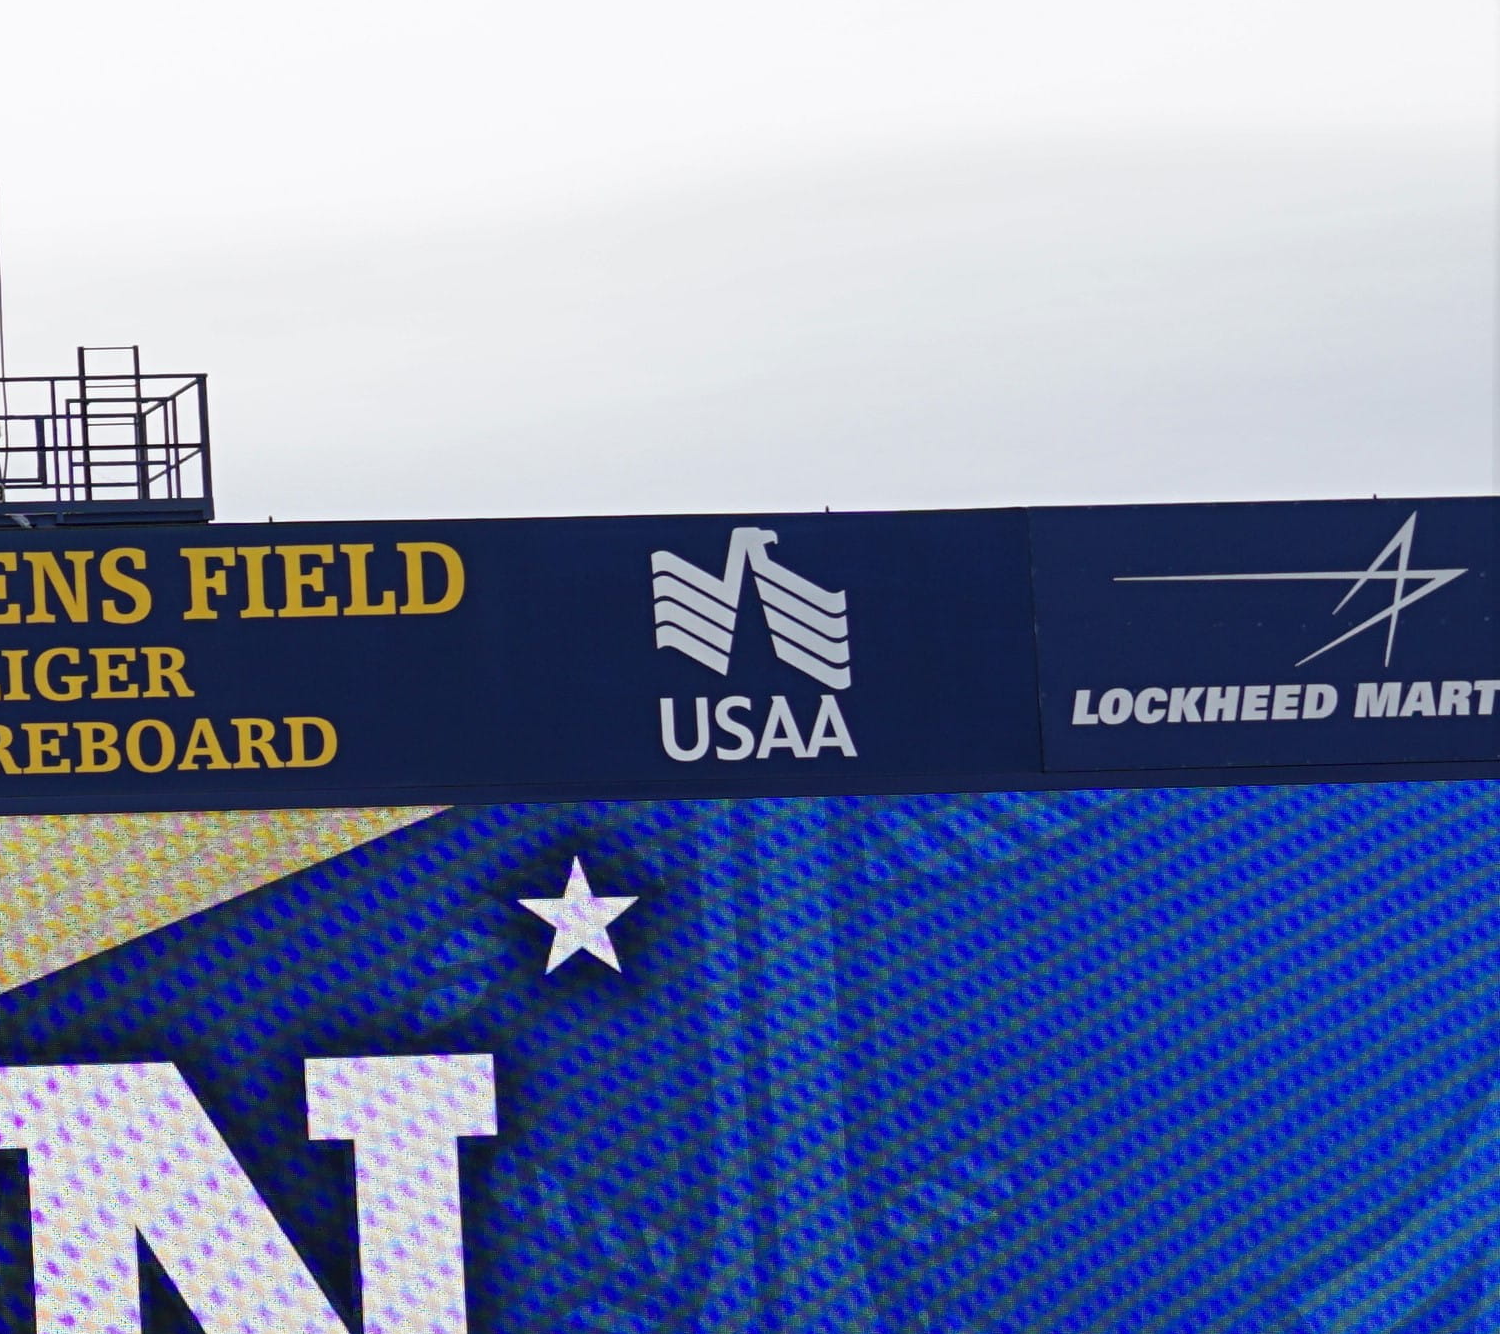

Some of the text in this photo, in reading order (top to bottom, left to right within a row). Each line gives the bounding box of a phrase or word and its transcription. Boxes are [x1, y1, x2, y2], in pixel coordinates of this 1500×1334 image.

[180, 541, 466, 621] FIELD
[660, 694, 859, 762] USAA
[1071, 683, 1338, 725] LOCKHEED
